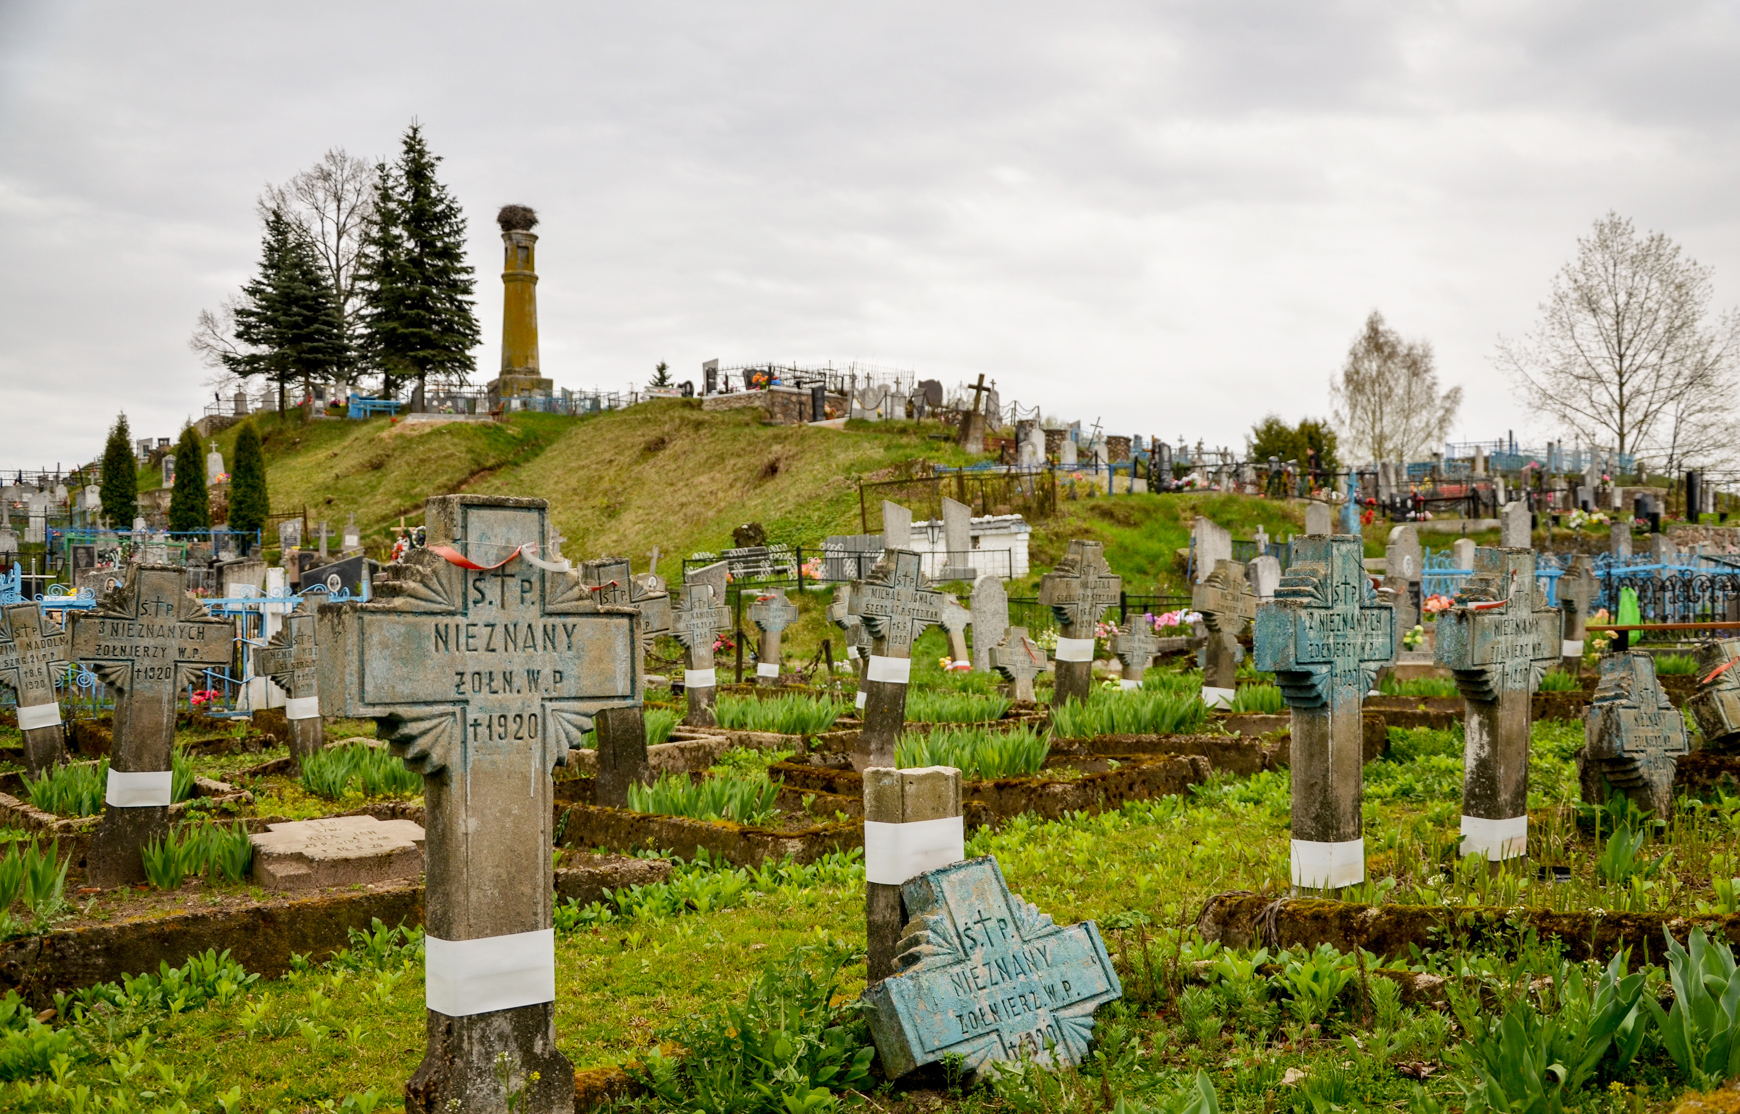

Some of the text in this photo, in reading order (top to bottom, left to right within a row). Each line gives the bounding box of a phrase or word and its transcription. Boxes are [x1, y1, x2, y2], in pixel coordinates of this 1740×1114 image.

[870, 588, 902, 602] MICHAŁ
[98, 621, 205, 641] 3 NIEZNANYCH
[1319, 612, 1382, 633] NIEZNANYCH
[1494, 617, 1540, 636] NIEZNANY
[433, 622, 578, 654] NIEZNANY
[25, 679, 46, 691] 1920
[950, 944, 1051, 998] NIEZNANY
